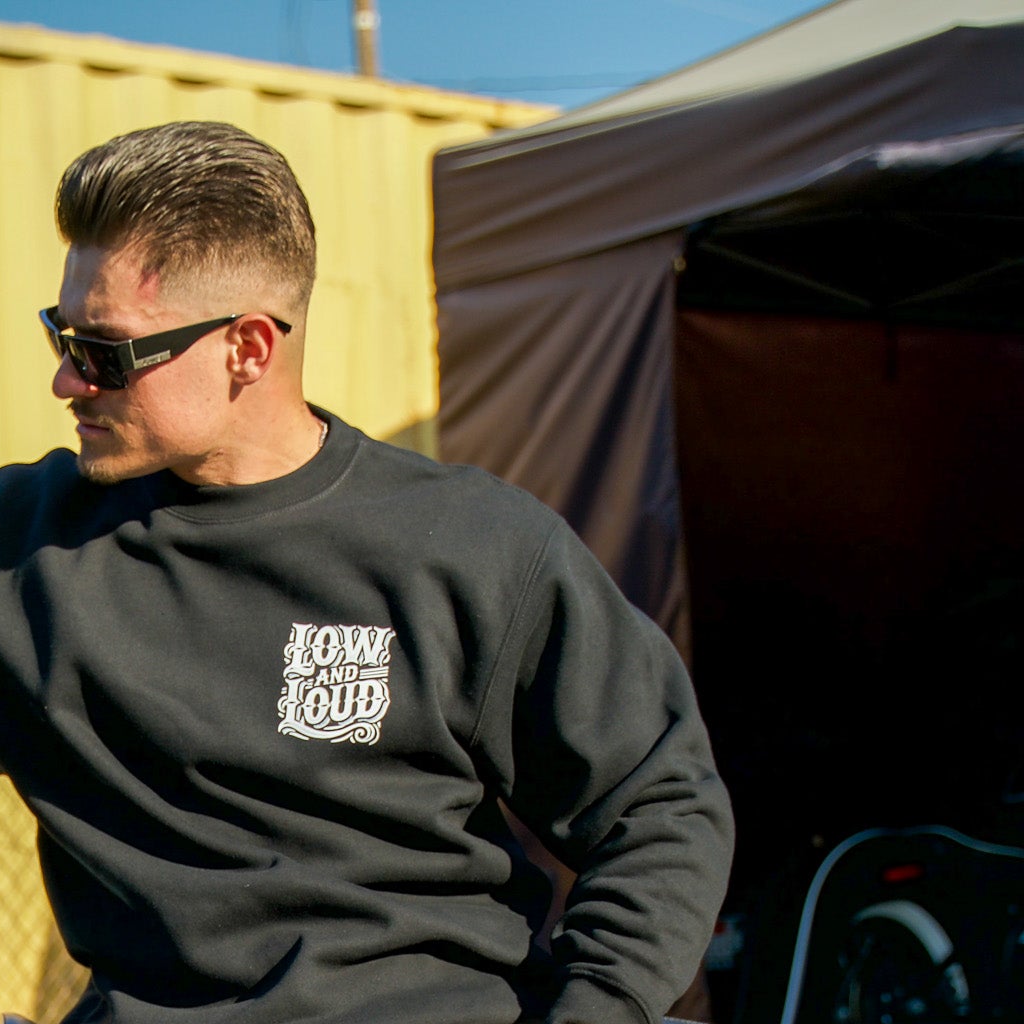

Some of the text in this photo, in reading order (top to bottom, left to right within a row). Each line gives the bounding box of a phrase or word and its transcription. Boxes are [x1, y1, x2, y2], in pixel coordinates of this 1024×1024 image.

[283, 622, 397, 679] LOW
[313, 665, 360, 687] AND
[277, 677, 392, 746] LOUD
